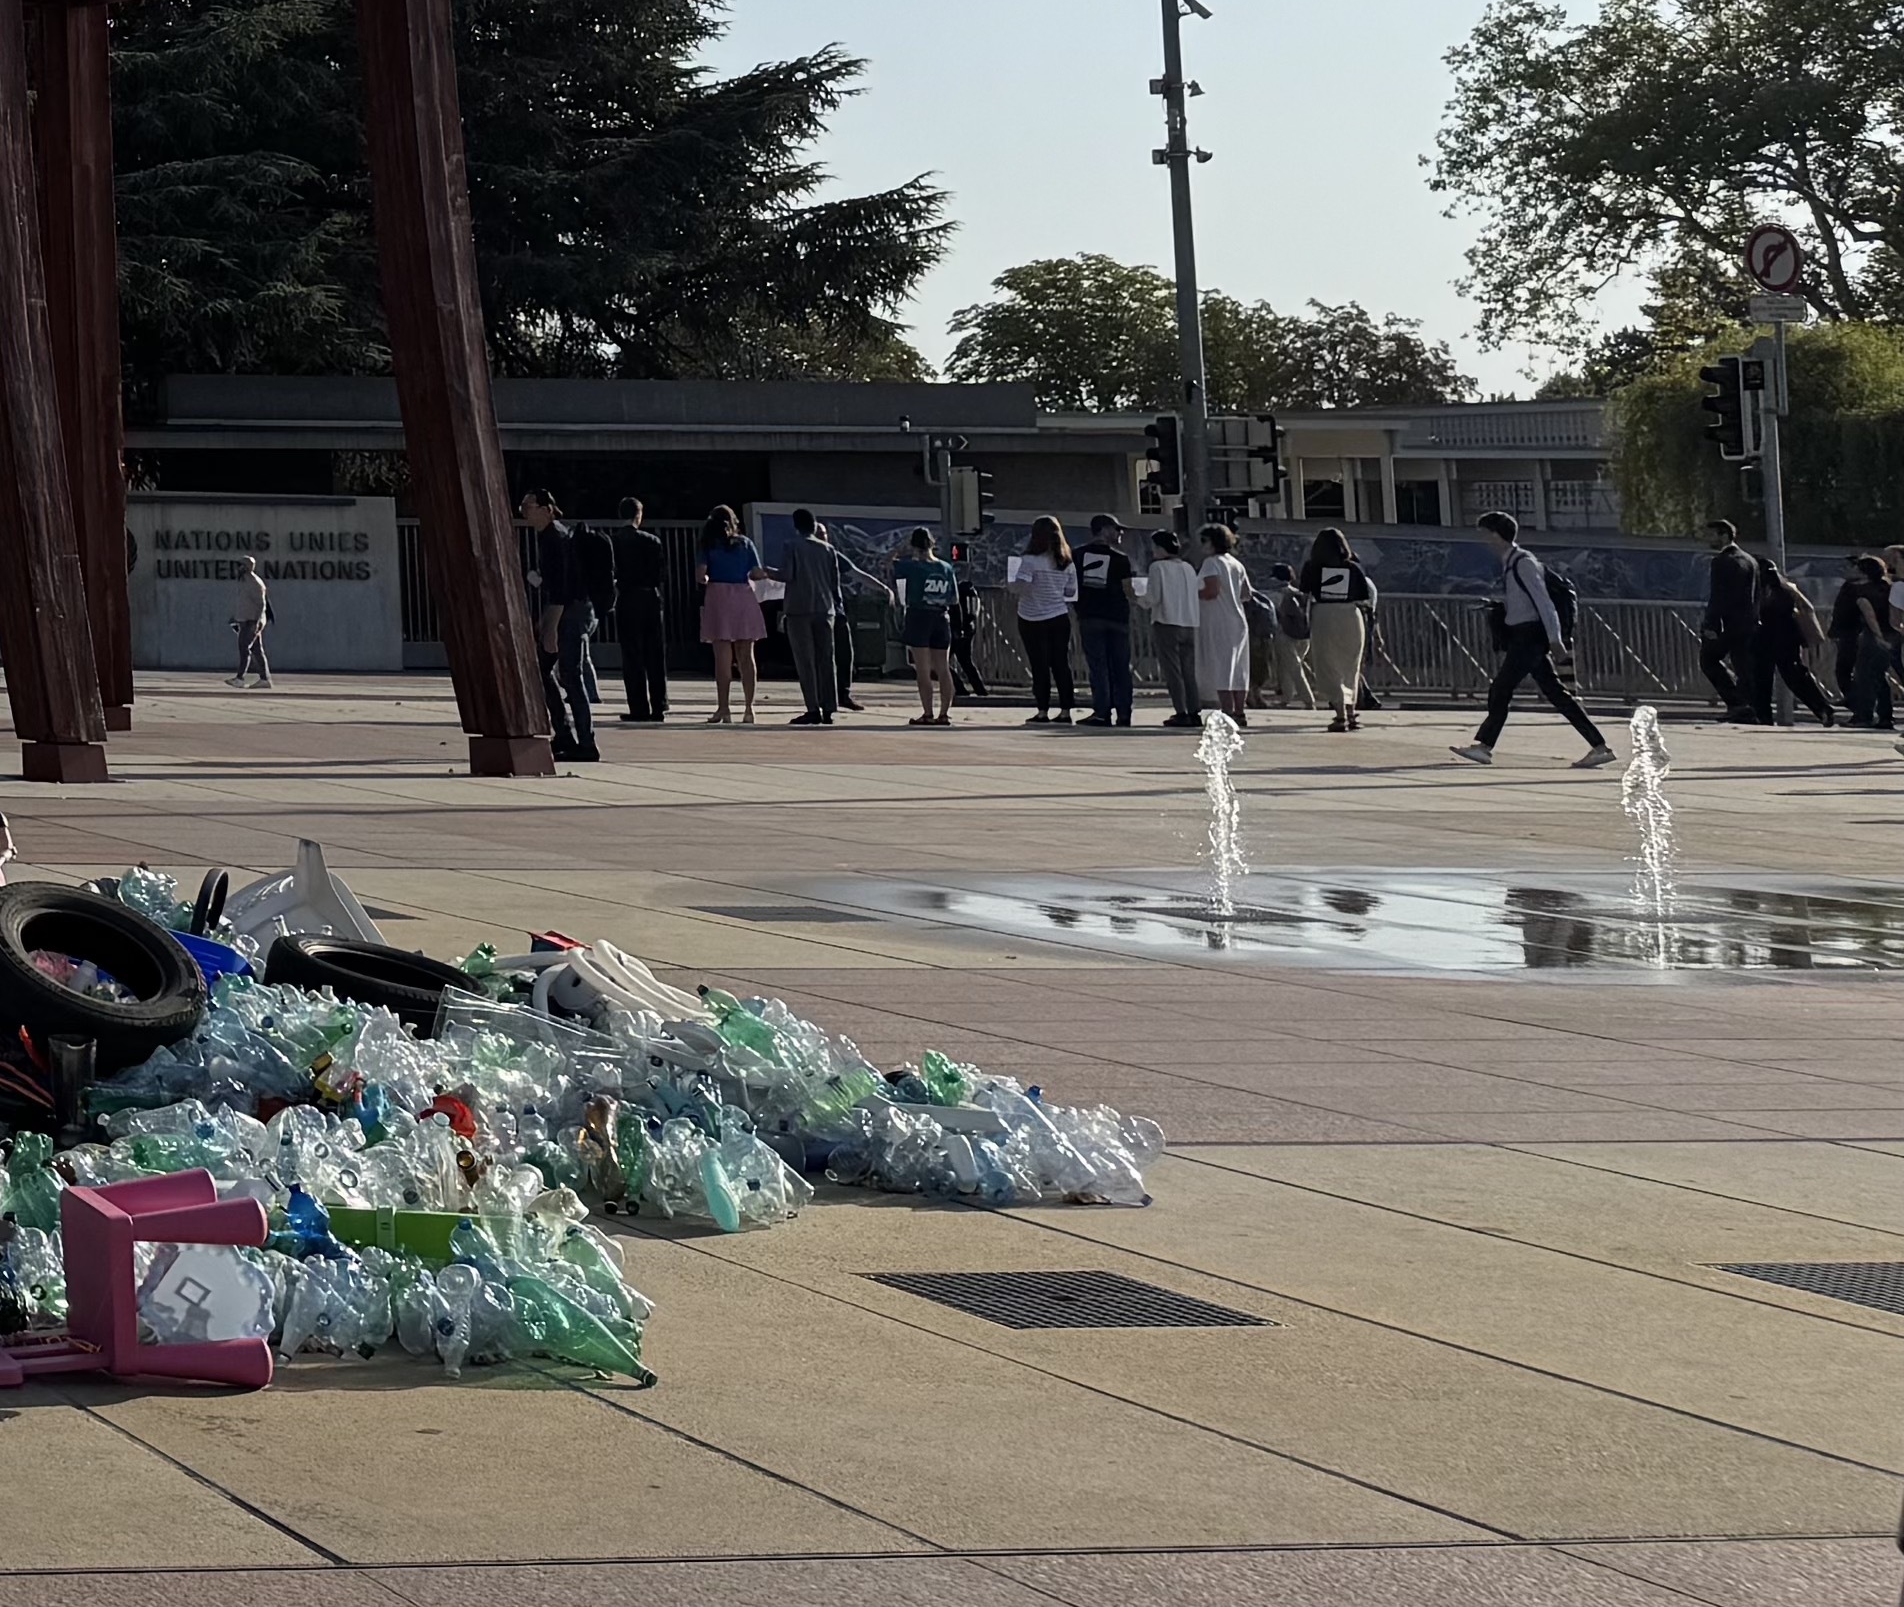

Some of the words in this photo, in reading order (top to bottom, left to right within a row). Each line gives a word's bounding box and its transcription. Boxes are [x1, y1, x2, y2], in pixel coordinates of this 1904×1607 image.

[155, 530, 271, 552] NATIONS
[289, 531, 370, 553] UNIES
[157, 559, 246, 581] UNITED
[263, 560, 371, 581] NATIONS
